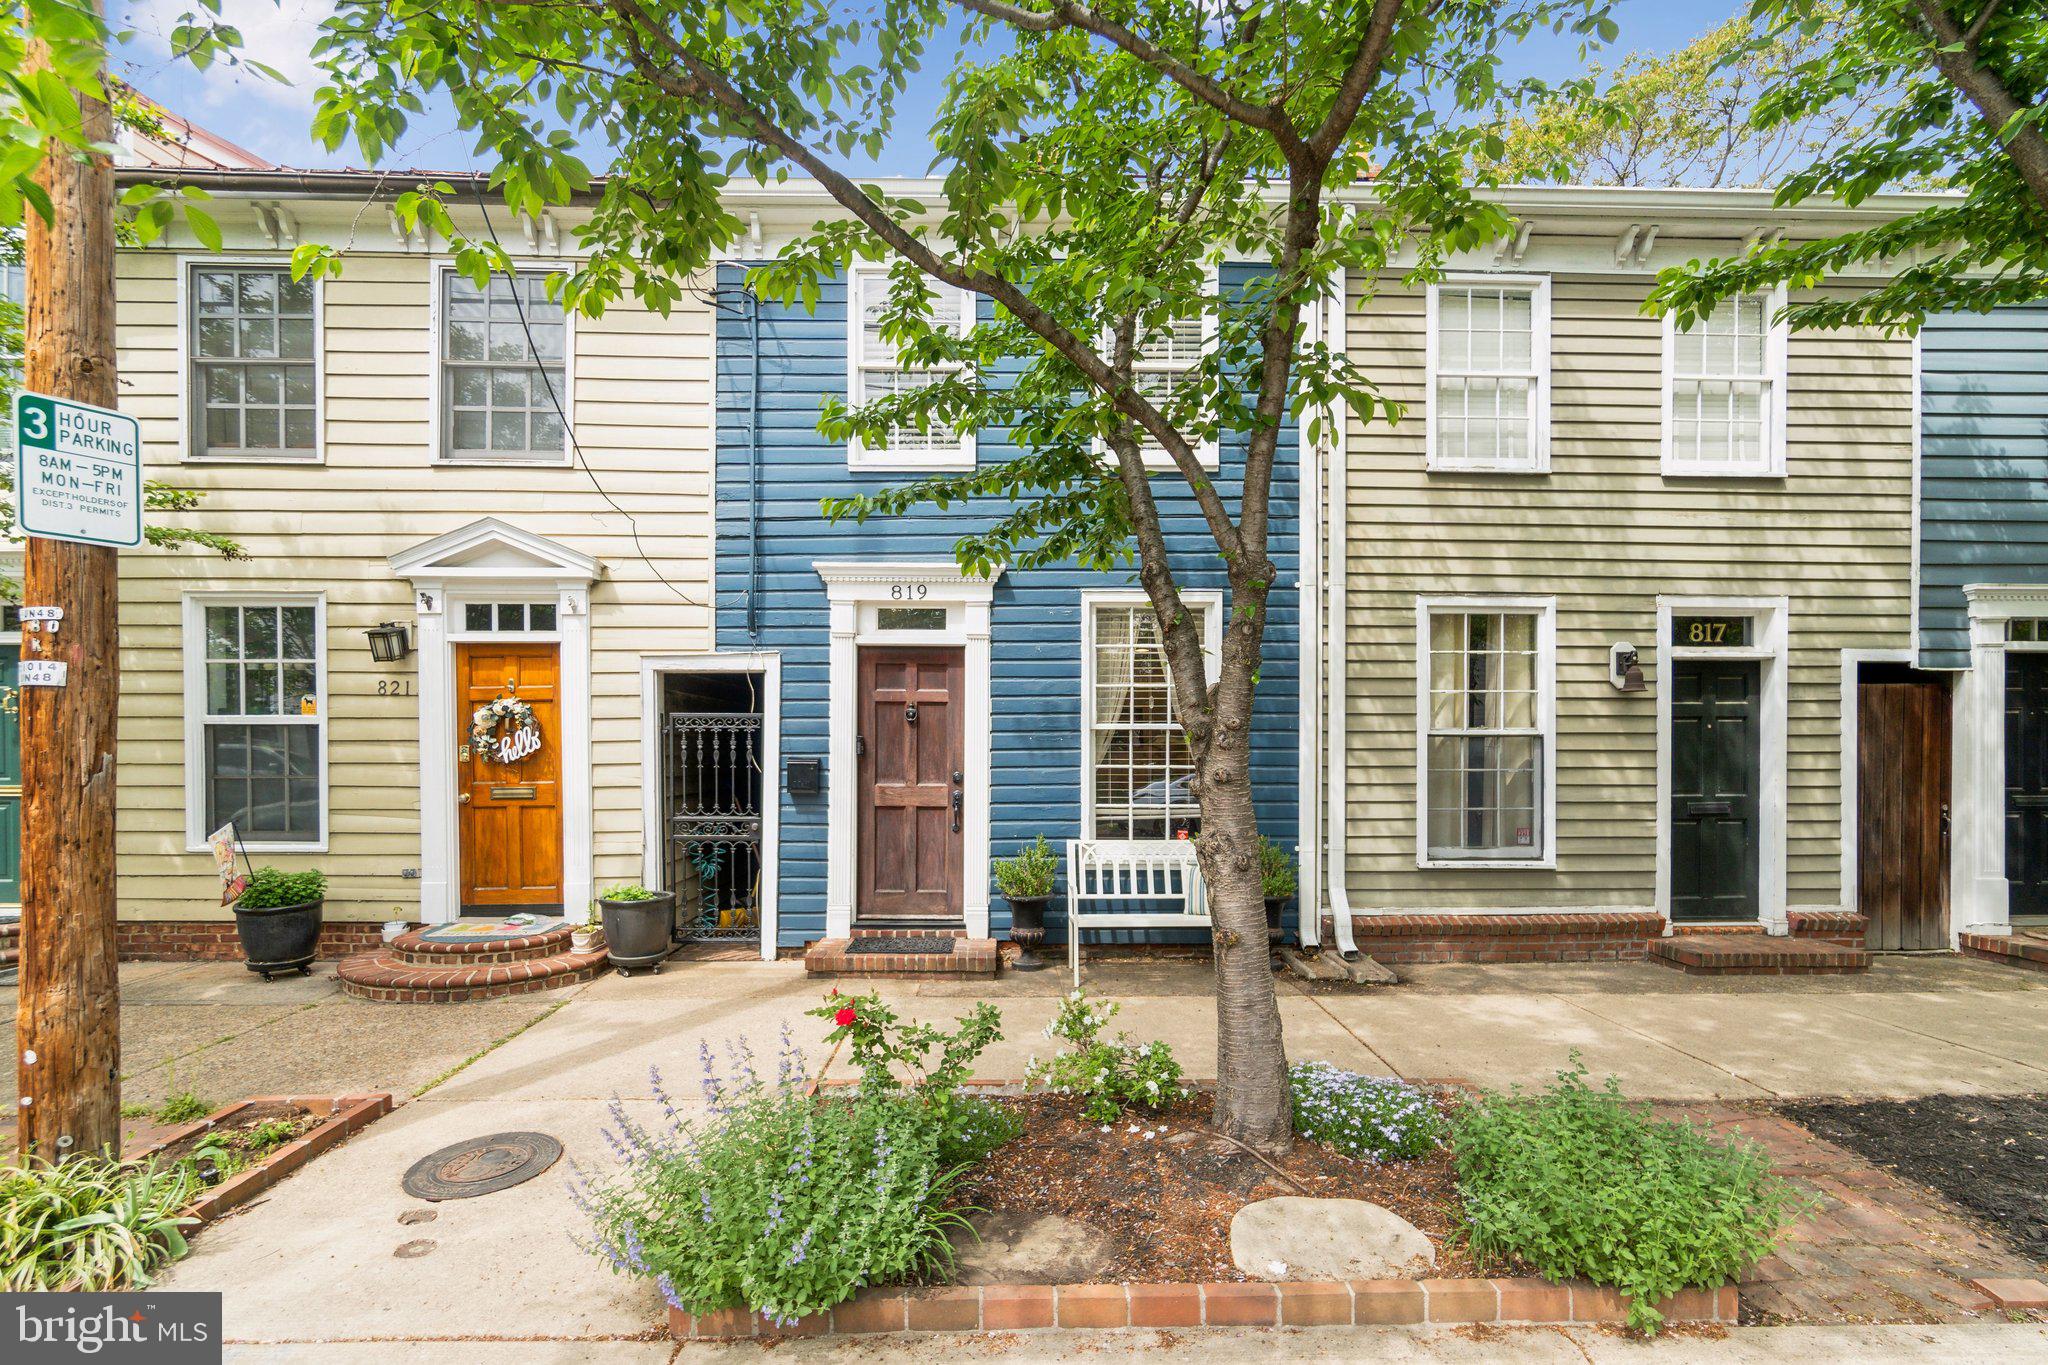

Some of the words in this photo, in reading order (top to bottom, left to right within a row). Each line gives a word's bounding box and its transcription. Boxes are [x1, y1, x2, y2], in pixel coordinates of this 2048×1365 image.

[24, 406, 48, 439] 3
[60, 412, 111, 436] HOUR
[60, 429, 133, 456] PARKING
[39, 454, 72, 471] 8AM
[93, 464, 123, 480] 5PM
[32, 487, 71, 500] EXCEPT
[80, 504, 121, 517] PERMITS
[891, 584, 927, 600] 819
[1689, 622, 1727, 643] 817
[378, 680, 410, 697] 821
[497, 726, 542, 764] hello
